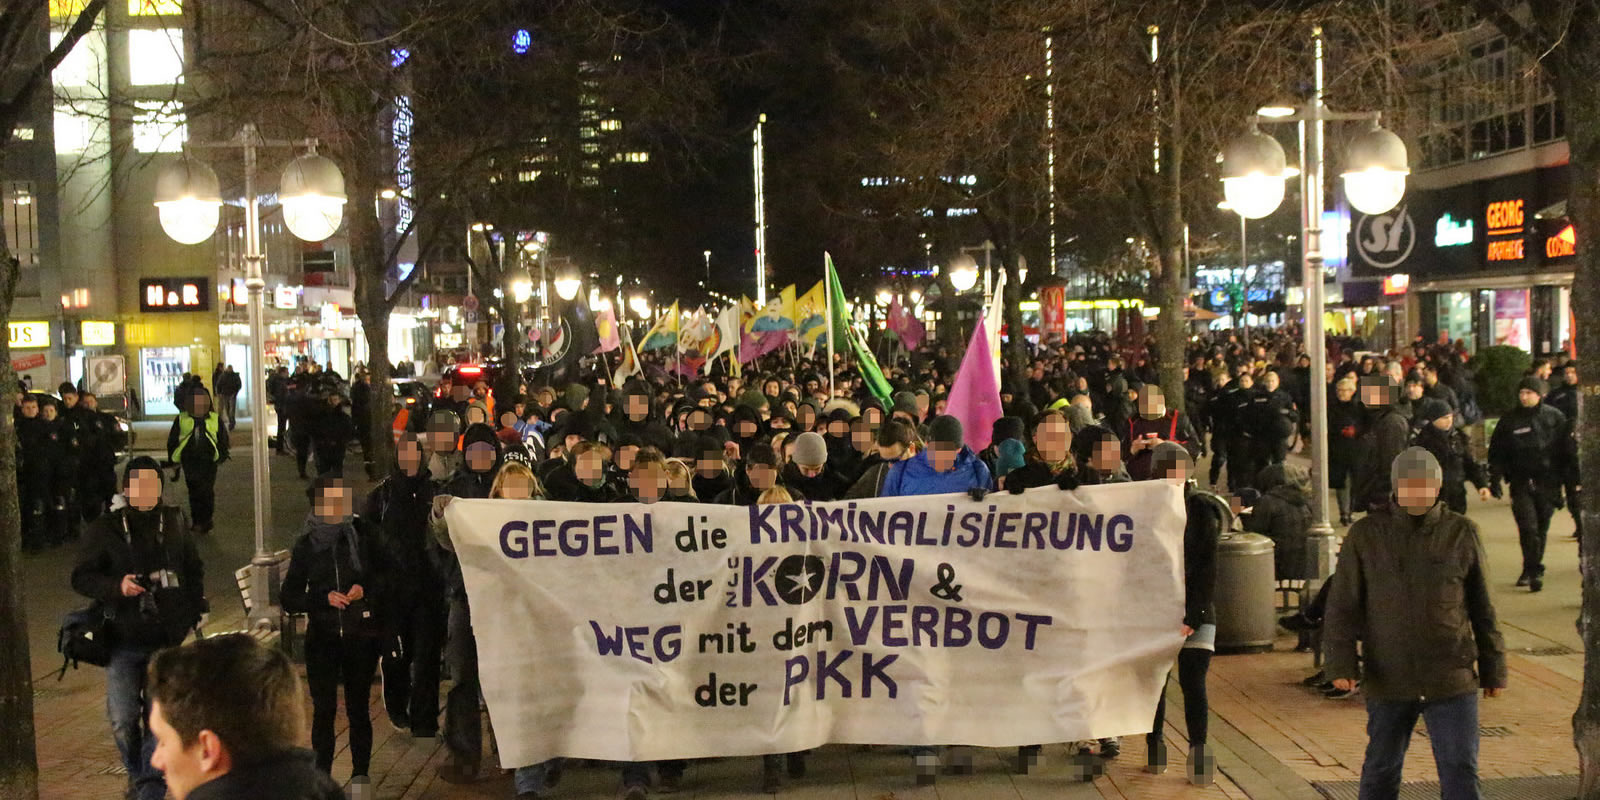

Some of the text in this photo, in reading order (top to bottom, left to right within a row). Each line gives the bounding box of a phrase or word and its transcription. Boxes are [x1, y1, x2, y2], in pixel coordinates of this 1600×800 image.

[1487, 199, 1524, 228] GEORG
[147, 285, 163, 306] H
[183, 284, 199, 305] R
[499, 513, 653, 558] GEGEN
[675, 516, 727, 552] die
[654, 568, 712, 604] der
[743, 551, 914, 607] KORN
[930, 563, 962, 602] &
[589, 605, 1052, 664] WEG mit dem VERBOT
[695, 650, 899, 706] der PKK
